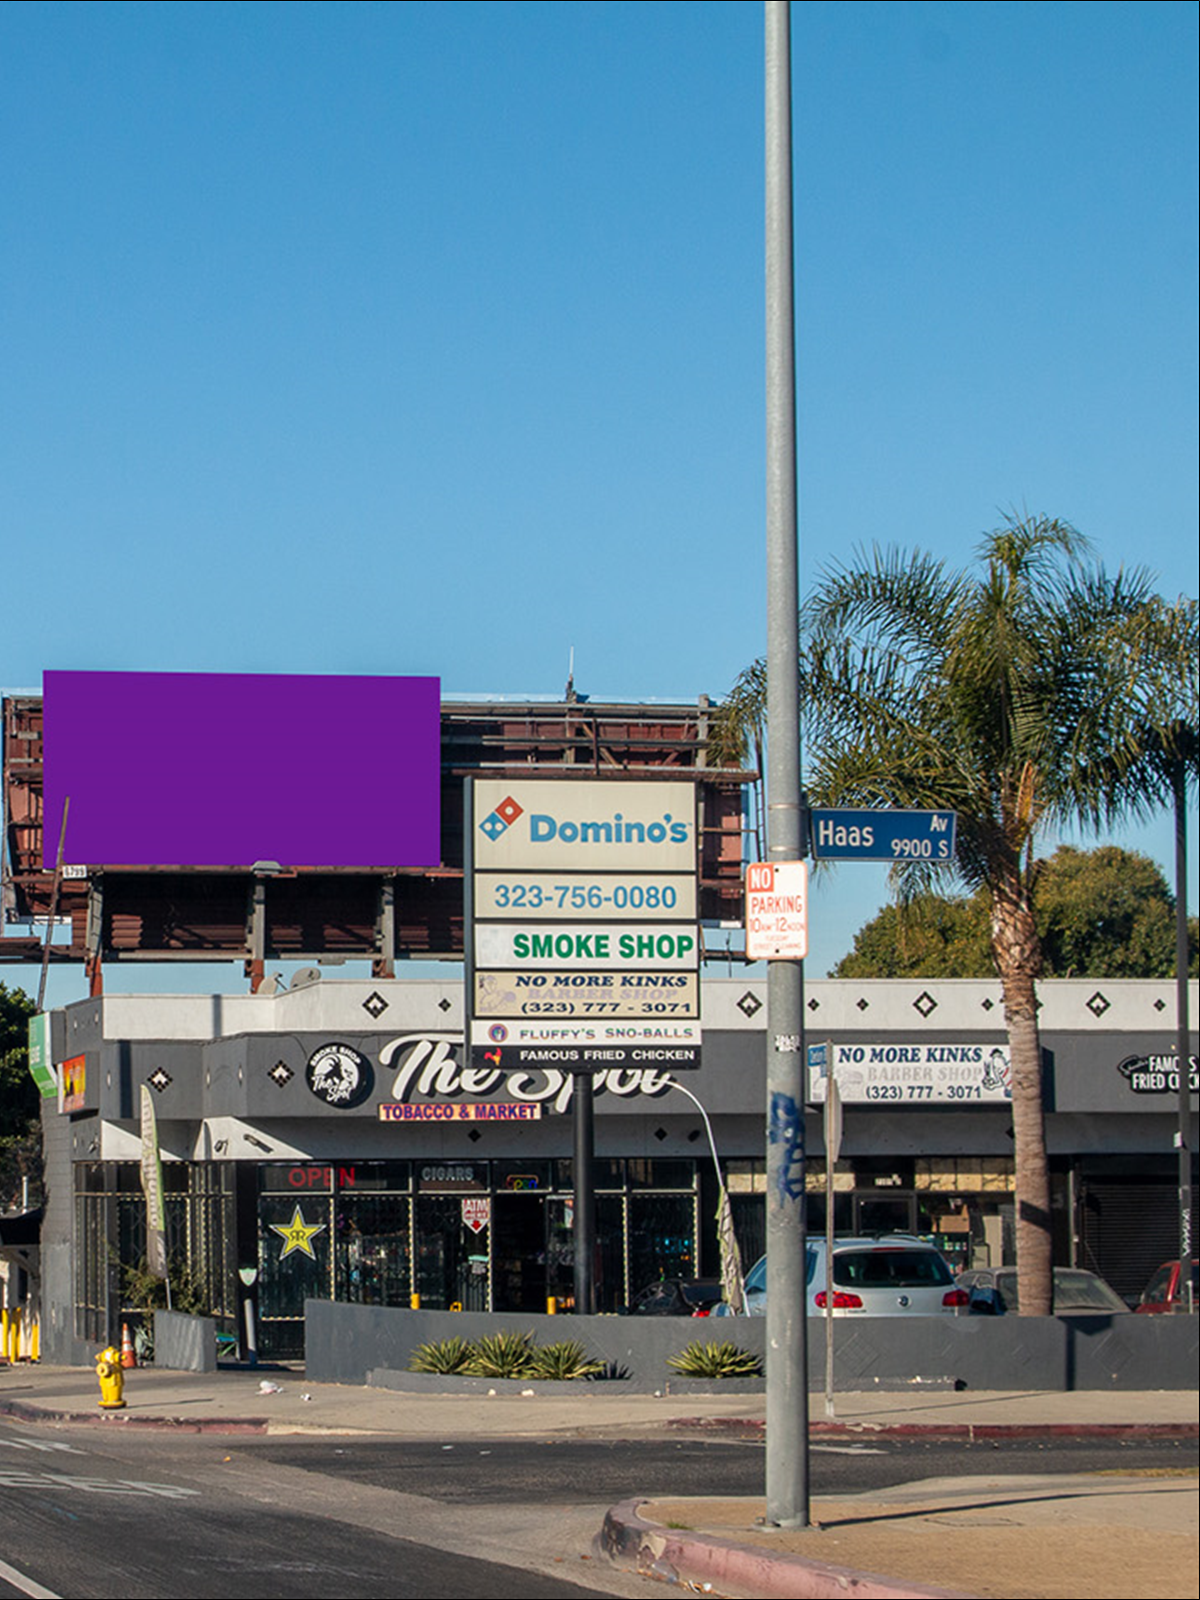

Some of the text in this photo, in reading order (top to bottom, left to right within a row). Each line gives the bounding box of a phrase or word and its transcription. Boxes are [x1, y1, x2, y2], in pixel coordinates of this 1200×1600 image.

[530, 813, 688, 843] Domino's
[819, 814, 948, 847] Haas Av
[891, 839, 949, 857] 9900 S
[751, 868, 771, 889] NO
[494, 884, 677, 909] 323-756-0080
[751, 895, 803, 914] PARKING
[513, 933, 694, 959] SMOKE SHOP
[515, 976, 688, 987] NO MORE KINKS
[528, 988, 678, 1000] BARBER SHOP
[521, 1002, 575, 1014] (323)
[583, 1003, 621, 1012] 777
[641, 1003, 691, 1013] 3071
[519, 1028, 693, 1040] FLUFFY'S SNO-BALLS
[340, 1046, 361, 1064] SHOP
[520, 1050, 695, 1061] FAMOUS FRIED CHICKEN
[838, 1048, 865, 1063] NO
[869, 1048, 921, 1063] MORE
[926, 1047, 983, 1063] KINKS
[379, 1033, 500, 1101] The
[1149, 1056, 1197, 1072] FAMOS
[868, 1066, 982, 1082] BARBER SHOP
[1132, 1073, 1166, 1089] FRIED
[866, 1086, 902, 1099] (323)
[907, 1086, 933, 1098] 777
[947, 1086, 981, 1099] 3071
[383, 1104, 537, 1119] TOBACCO & MARKET
[288, 1167, 355, 1187] OPEN
[422, 1167, 474, 1181] CIGARS
